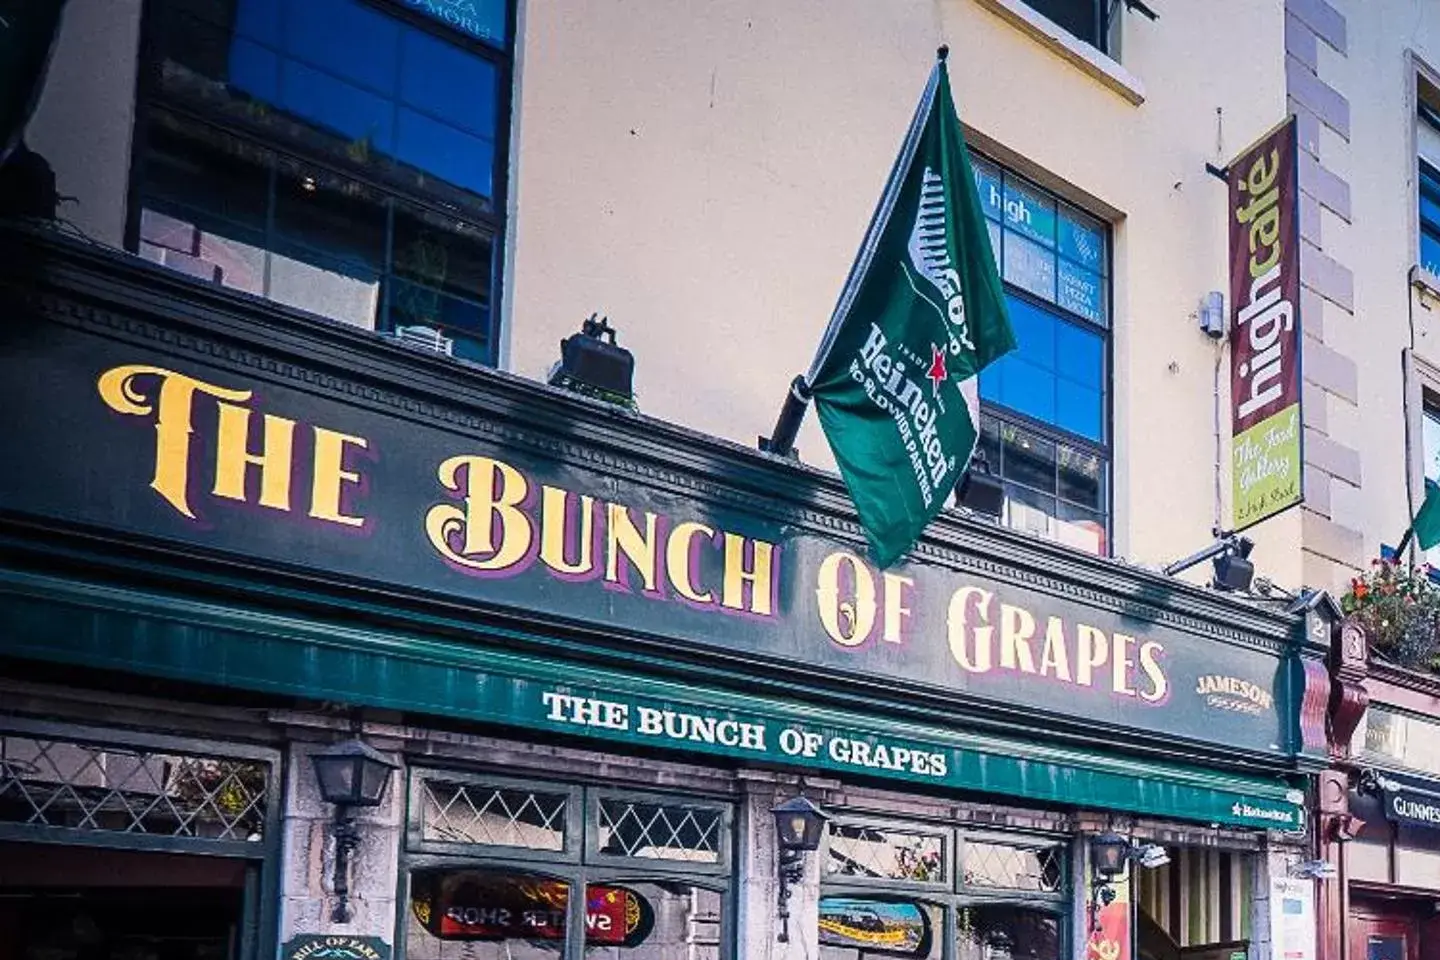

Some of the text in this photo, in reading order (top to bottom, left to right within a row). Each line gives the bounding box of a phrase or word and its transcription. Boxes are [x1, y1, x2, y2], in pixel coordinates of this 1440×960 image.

[989, 185, 1031, 225] high
[1237, 146, 1293, 420] highcafé
[860, 321, 951, 488] Heineken
[97, 363, 1169, 703] THE BUNCH OF GRAPES
[1312, 617, 1325, 638] 2
[1196, 674, 1273, 710] JAMESON
[542, 690, 948, 779] THE BUNCH OF GRAPES
[326, 936, 348, 948] OF
